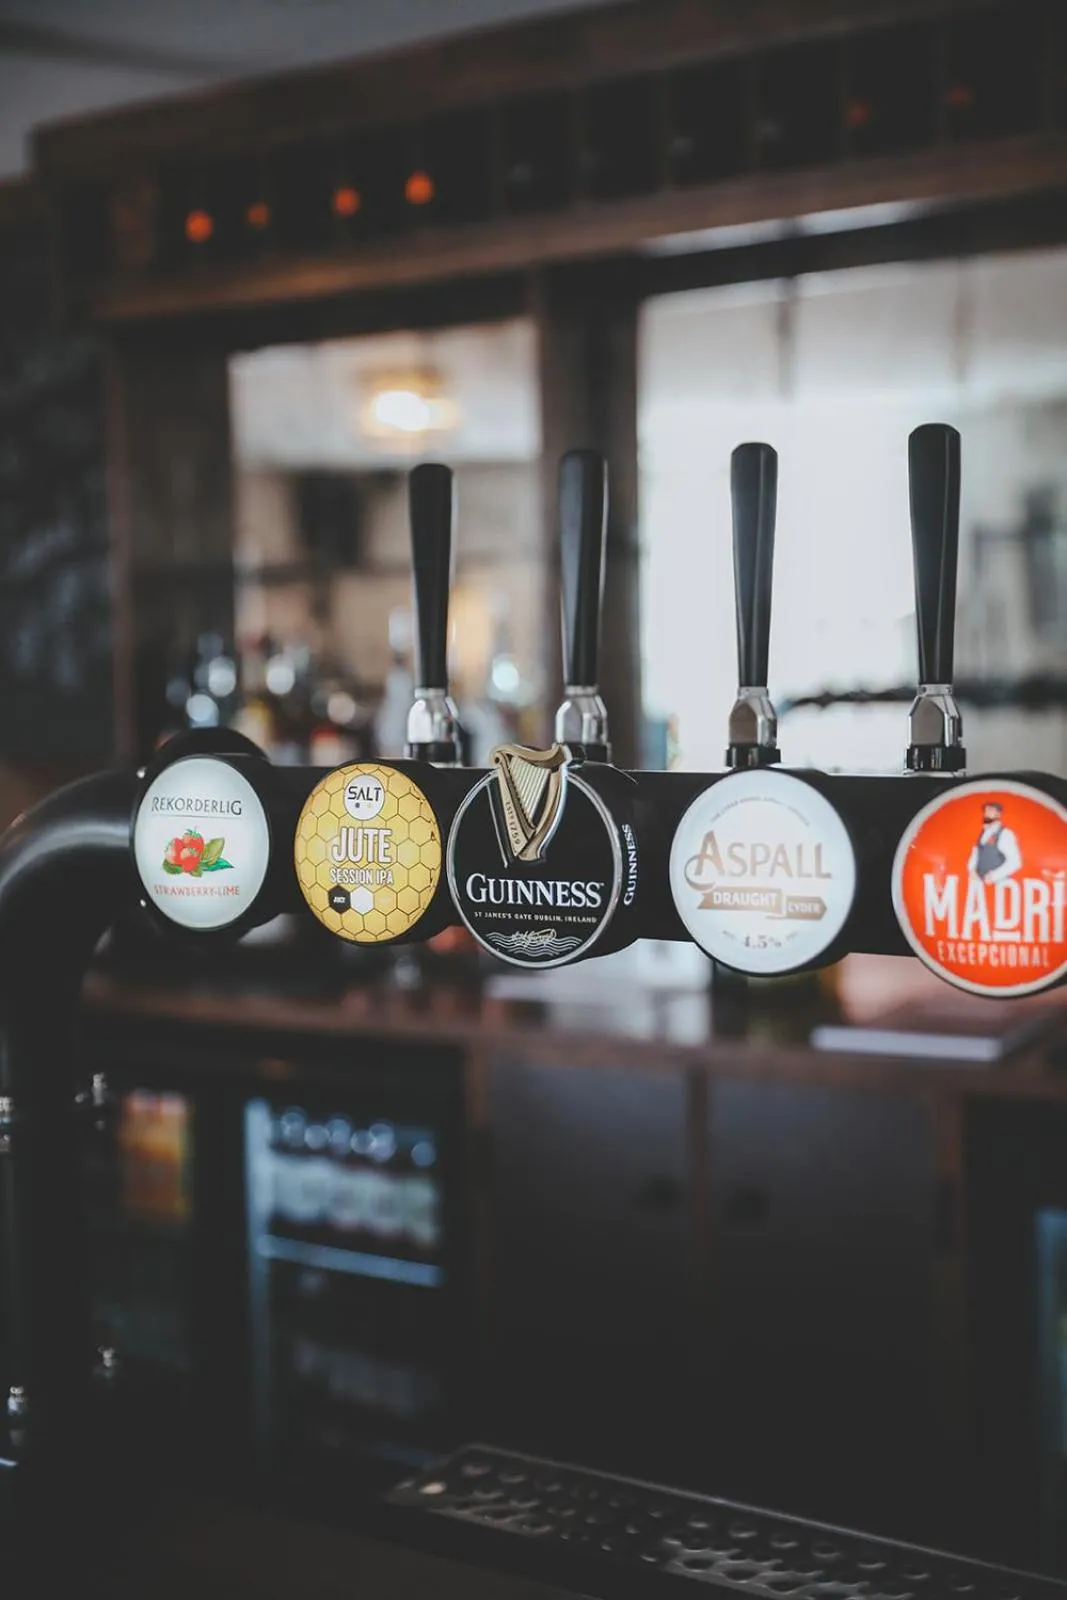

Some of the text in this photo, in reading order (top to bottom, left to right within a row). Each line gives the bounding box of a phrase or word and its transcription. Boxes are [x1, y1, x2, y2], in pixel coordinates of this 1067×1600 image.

[348, 786, 382, 802] SALT
[151, 796, 242, 816] REKORDERLIG
[332, 826, 393, 864] JUTE
[622, 824, 639, 906] GUINNESS
[685, 830, 831, 888] ASPALL
[330, 868, 394, 886] SESSION IPA
[153, 885, 240, 897] STRAWBERRY-LIME
[466, 873, 602, 908] GUINNESS
[712, 890, 778, 908] DRAUGHT
[514, 913, 532, 921] GATE
[564, 915, 597, 924] IRELAND
[936, 940, 1050, 968] EXCEPCIONAL
